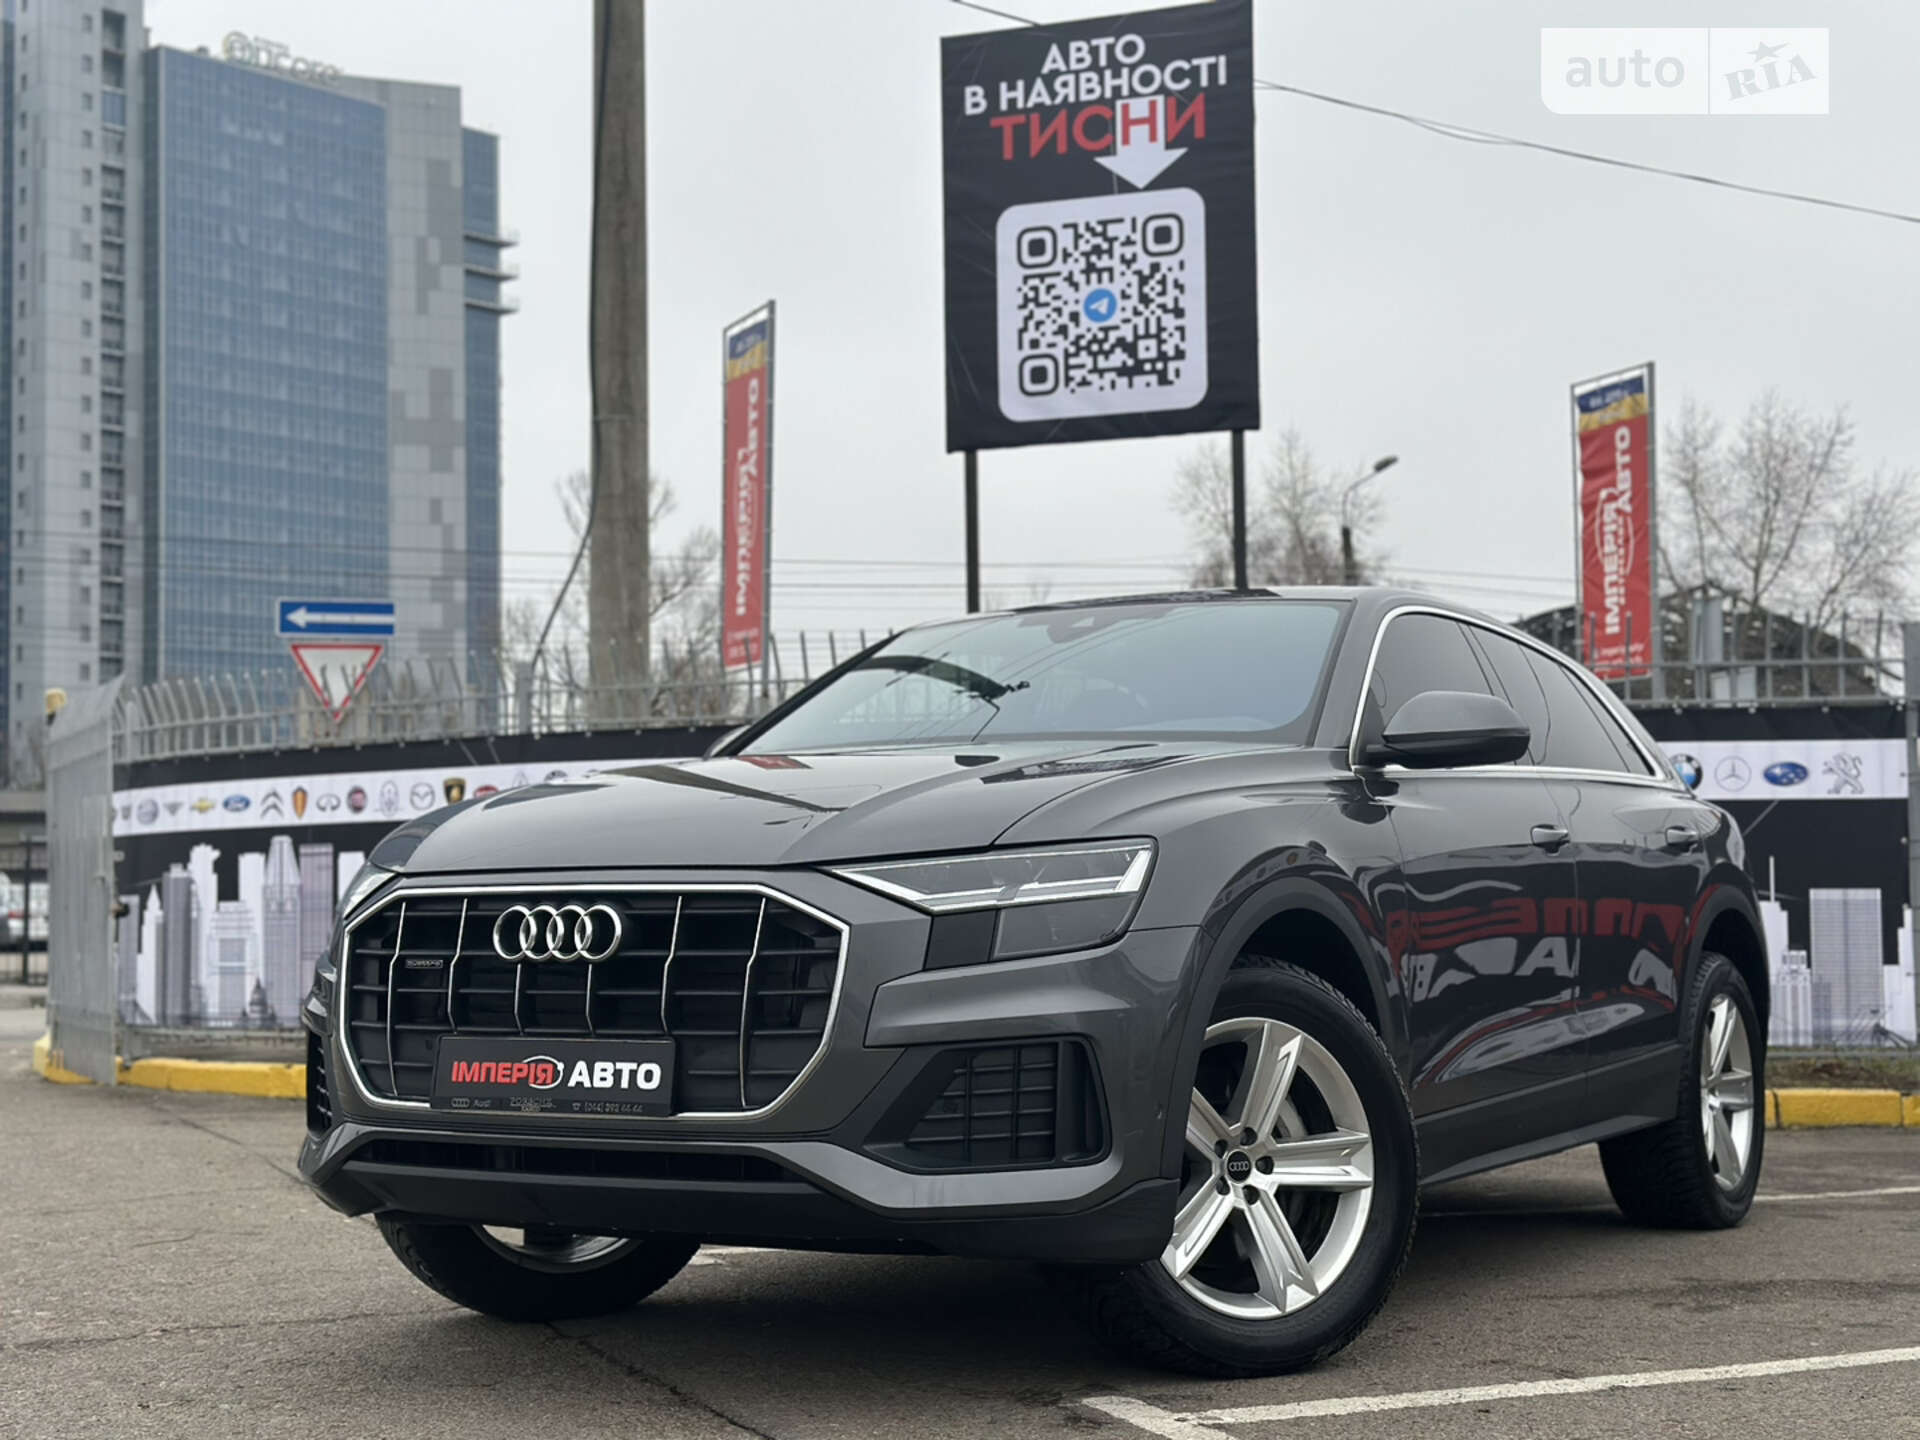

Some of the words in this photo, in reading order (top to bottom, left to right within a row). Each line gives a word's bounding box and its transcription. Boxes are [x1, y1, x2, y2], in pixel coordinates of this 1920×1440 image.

[964, 85, 988, 115] В
[1000, 55, 1227, 112] НАЯВНОСТІ
[1041, 34, 1145, 75] АВТО
[990, 93, 1206, 161] ТИСНИ
[1615, 426, 1632, 513] АВТО
[1603, 502, 1620, 635] ІМПЕРІЯ
[451, 1060, 555, 1086] ІМПЕРІЯ
[567, 1060, 662, 1090] АВТО
